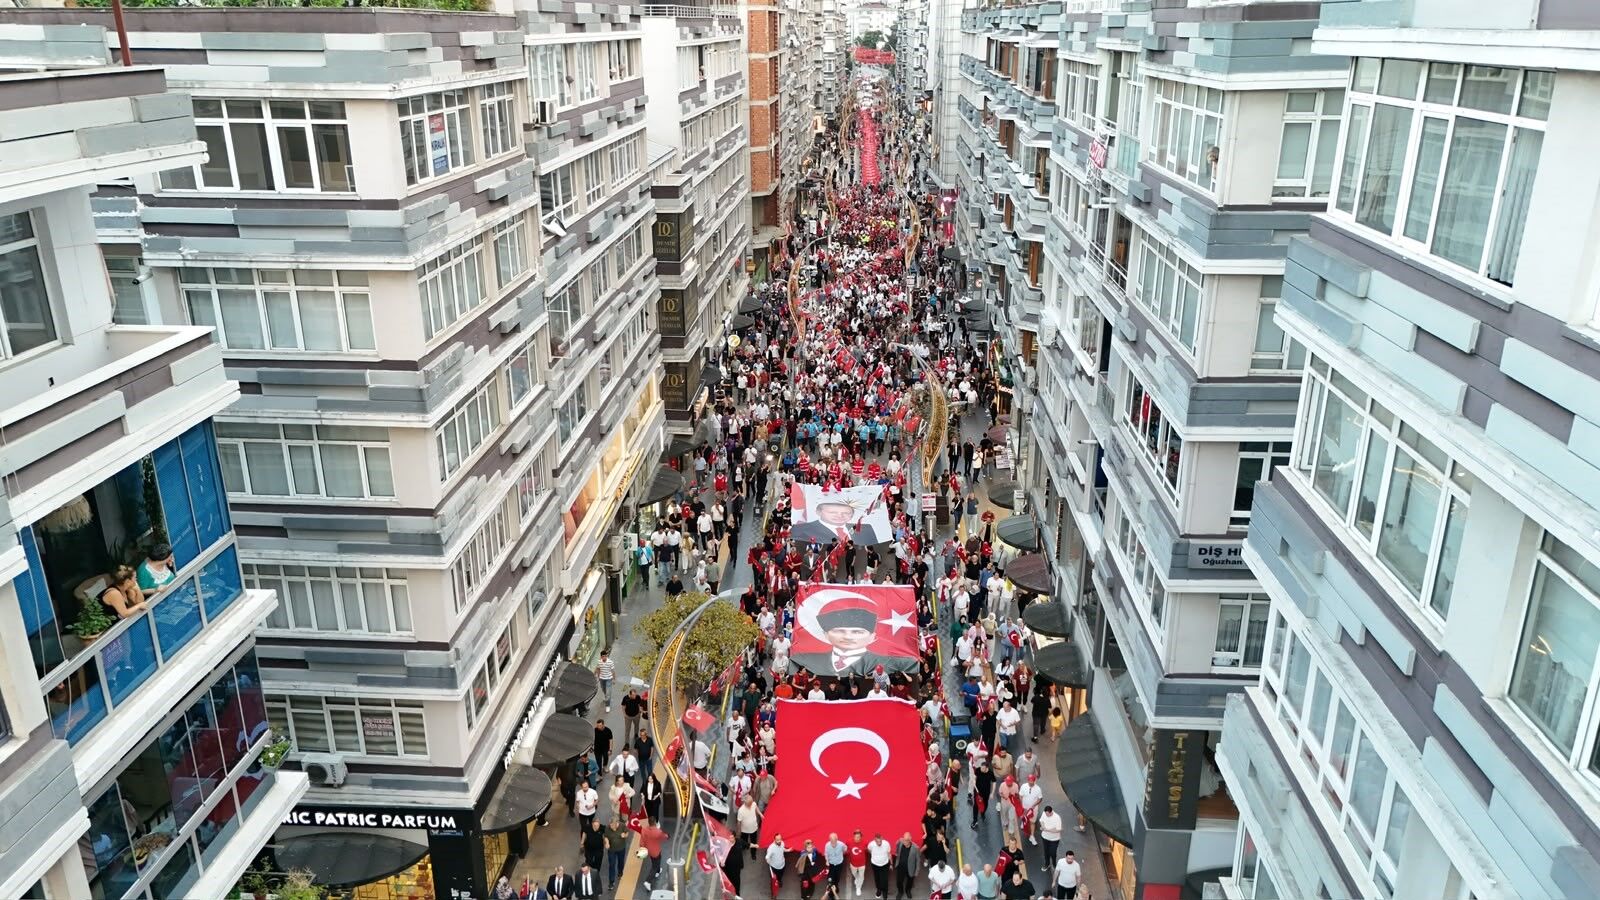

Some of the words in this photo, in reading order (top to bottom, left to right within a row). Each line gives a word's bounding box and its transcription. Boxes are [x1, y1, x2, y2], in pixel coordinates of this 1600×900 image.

[657, 222, 675, 237] DC
[662, 297, 680, 313] DC
[1198, 546, 1223, 557] DİŞ
[1203, 558, 1243, 566] Oğuzhan
[315, 812, 377, 826] PATRIC
[381, 814, 456, 829] PARFUM
